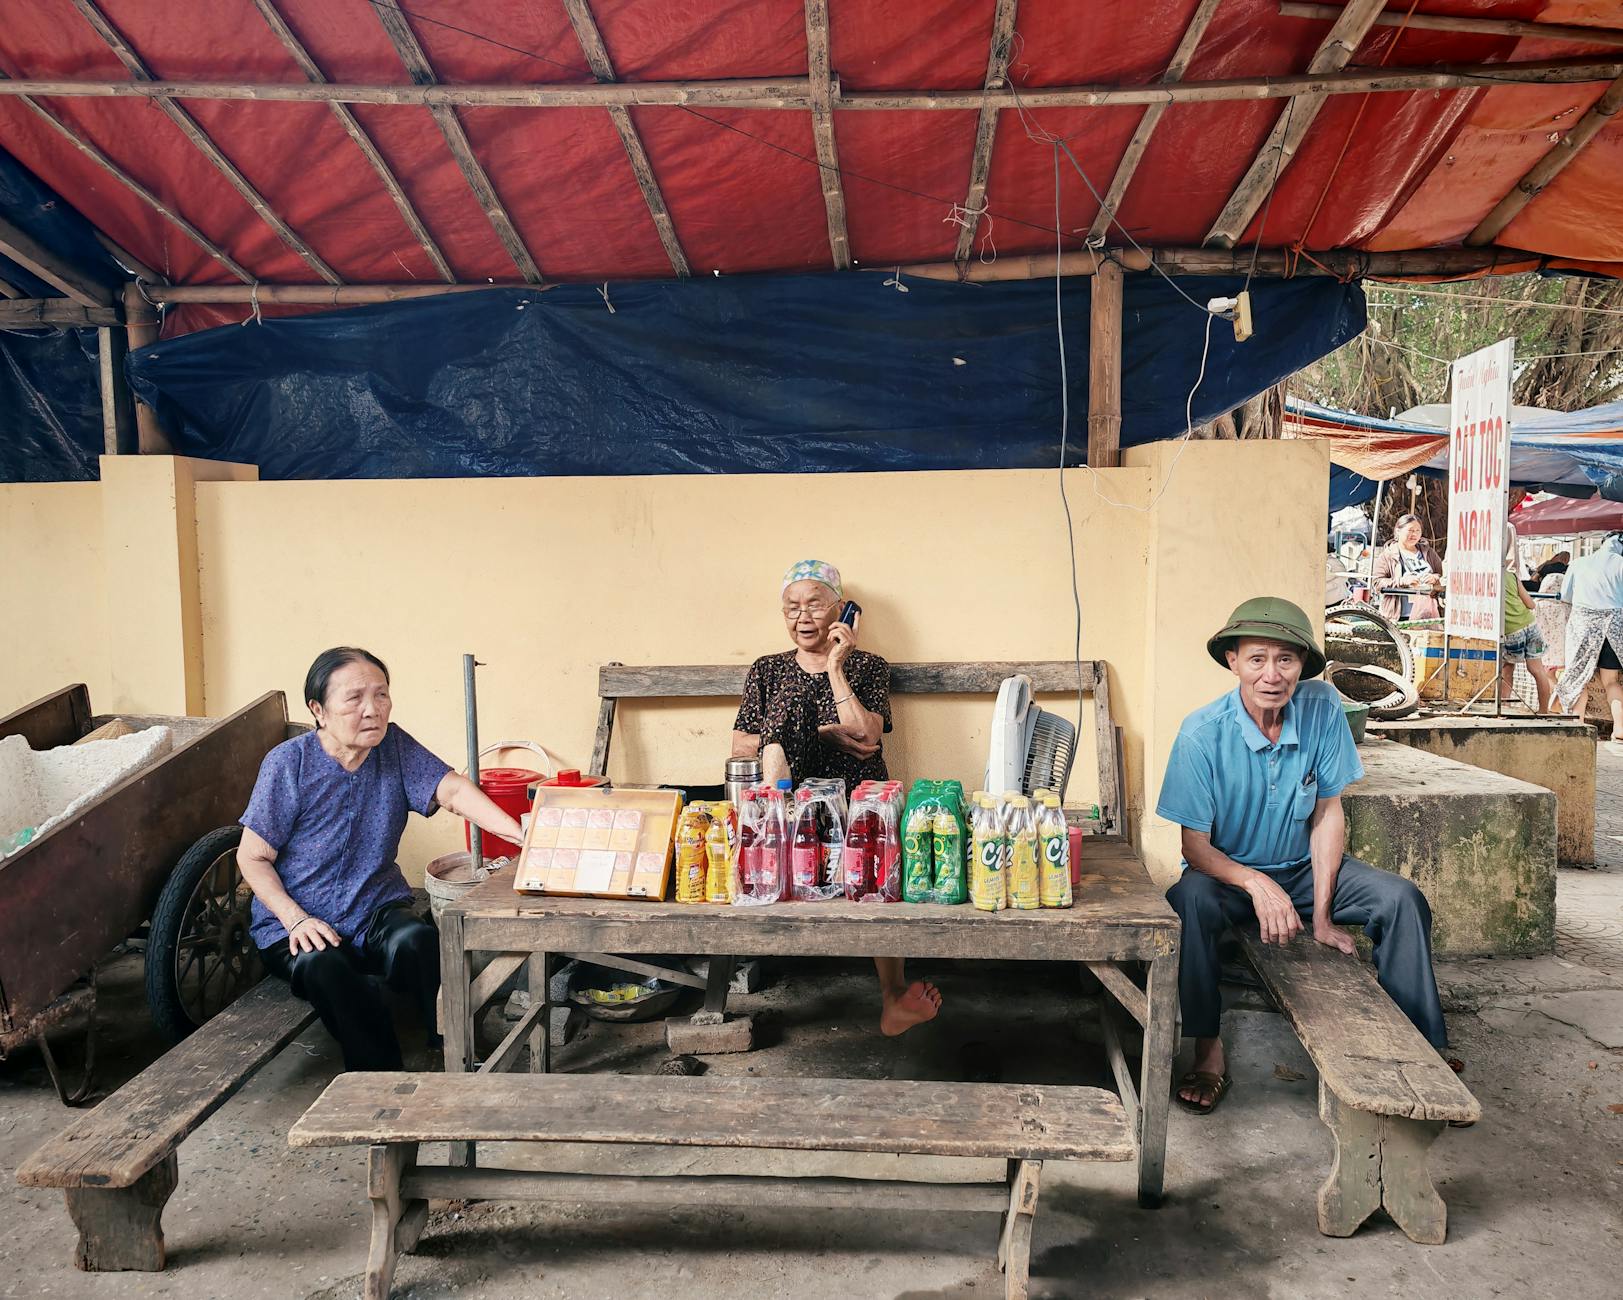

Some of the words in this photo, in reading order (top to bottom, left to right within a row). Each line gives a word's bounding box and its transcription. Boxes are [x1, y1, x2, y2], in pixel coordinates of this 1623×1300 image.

[1454, 400, 1476, 494] CẮT
[1479, 402, 1502, 490] TÓC
[1458, 509, 1491, 551] NAM
